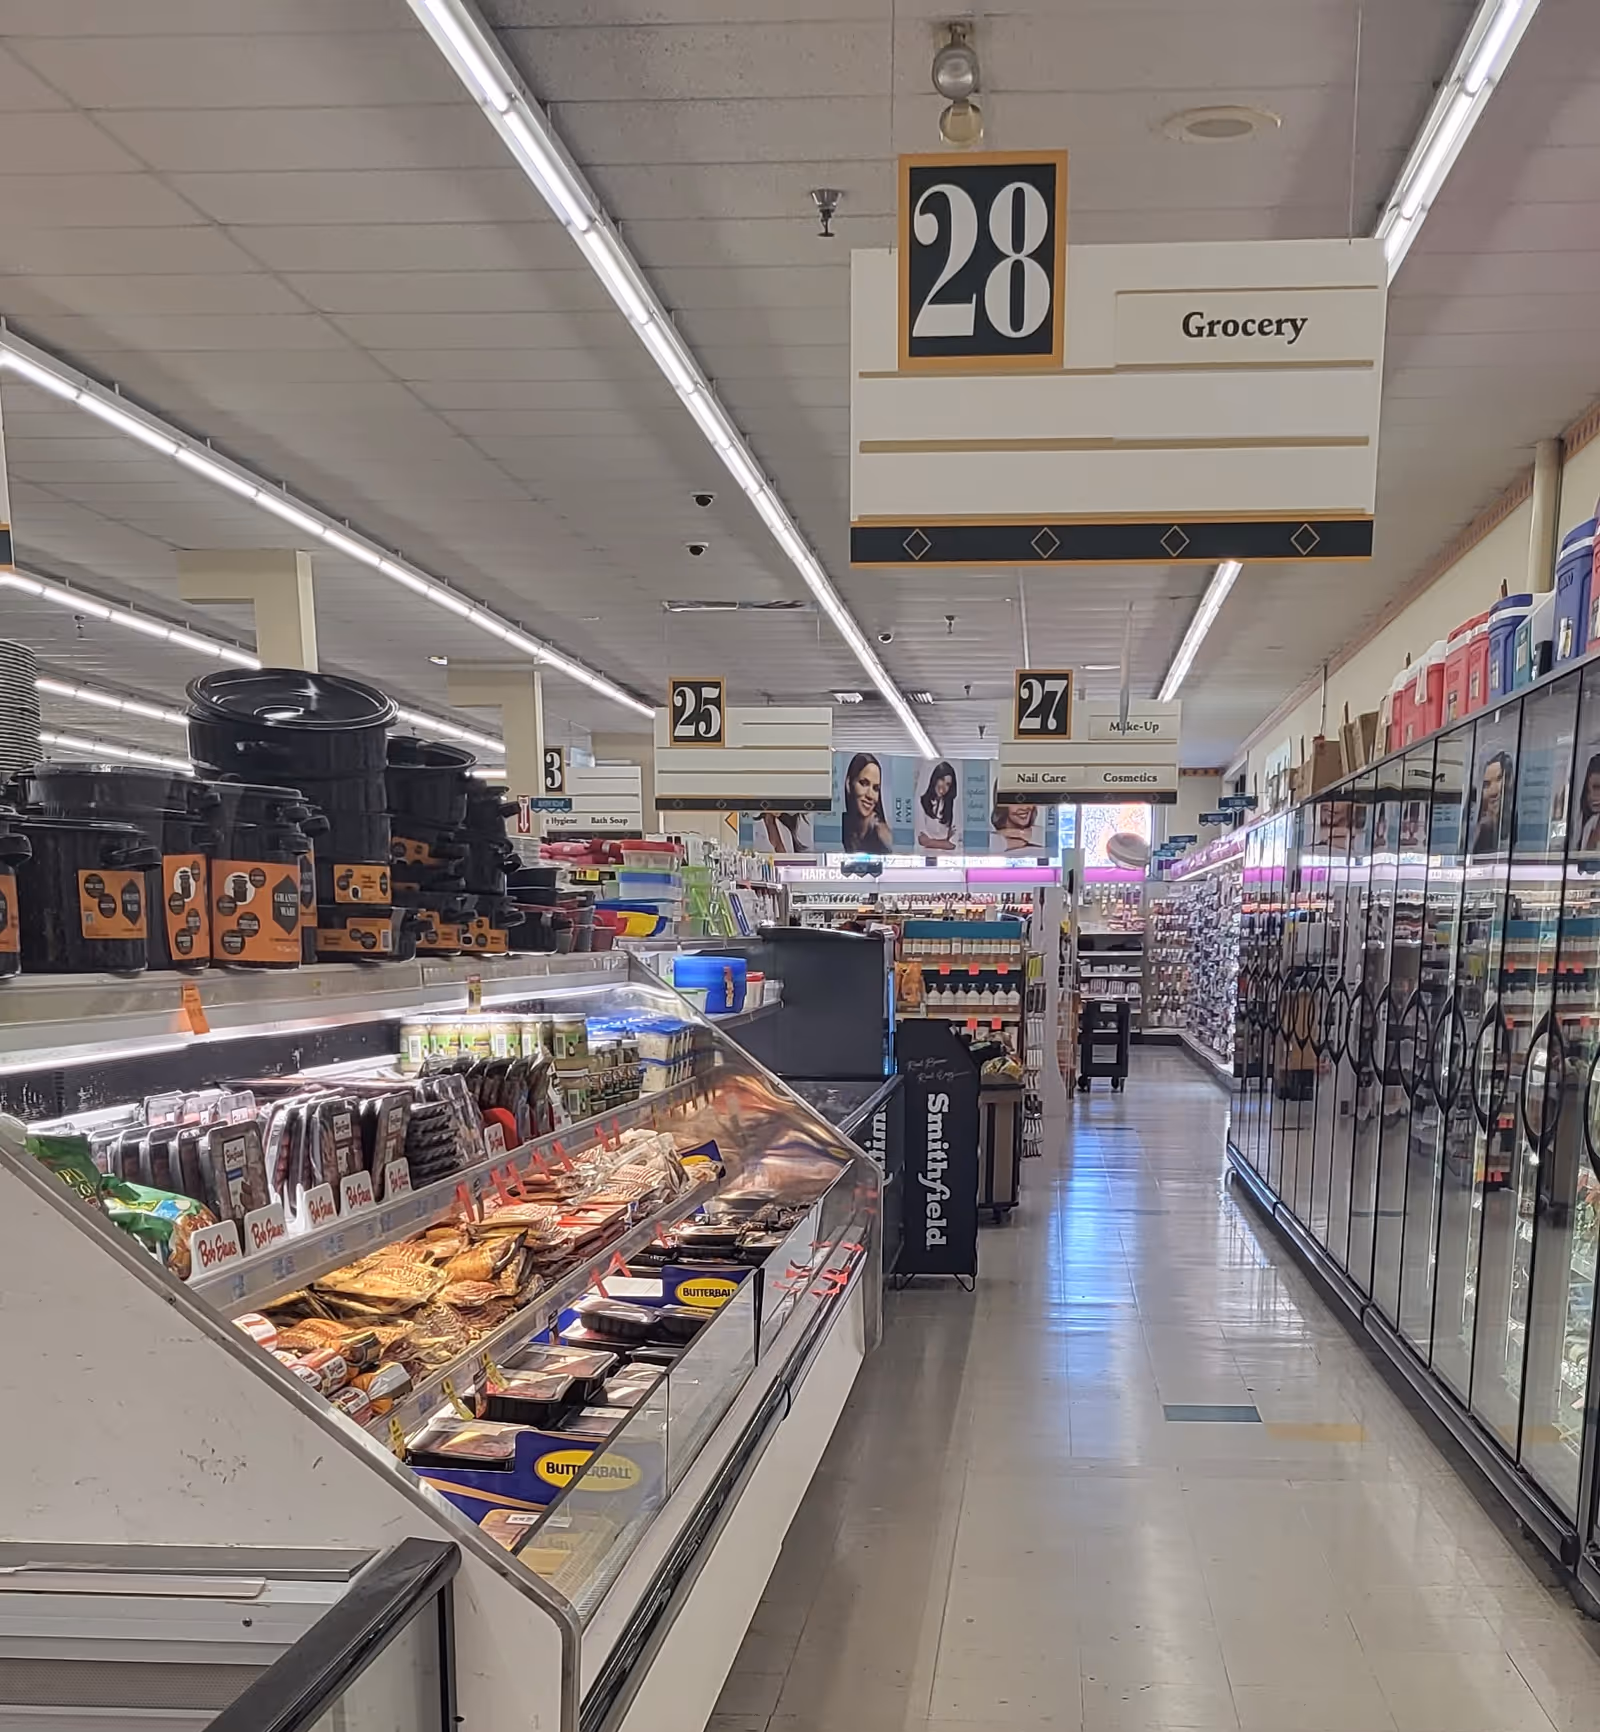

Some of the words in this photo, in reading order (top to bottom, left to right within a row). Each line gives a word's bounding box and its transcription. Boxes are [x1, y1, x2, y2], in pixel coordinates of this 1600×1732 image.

[912, 181, 1051, 340] 28
[1182, 311, 1308, 343] Grocery
[673, 685, 721, 738] 25
[1019, 678, 1068, 730] 27
[1108, 721, 1160, 733] Mke-Up
[1016, 773, 1039, 783] Nail
[1041, 773, 1067, 783] Care
[1103, 772, 1158, 783] Cosmetics
[550, 816, 578, 826] Hygiene
[590, 816, 608, 825] Bath
[609, 817, 629, 826] Soap
[801, 868, 826, 880] HAIR
[917, 1093, 950, 1246] Smithfield
[251, 1222, 267, 1249] Bob
[266, 1218, 285, 1244] Evans
[198, 1239, 216, 1268] Bob
[215, 1234, 238, 1263] Evans
[682, 1287, 735, 1298] BUTTERBAL
